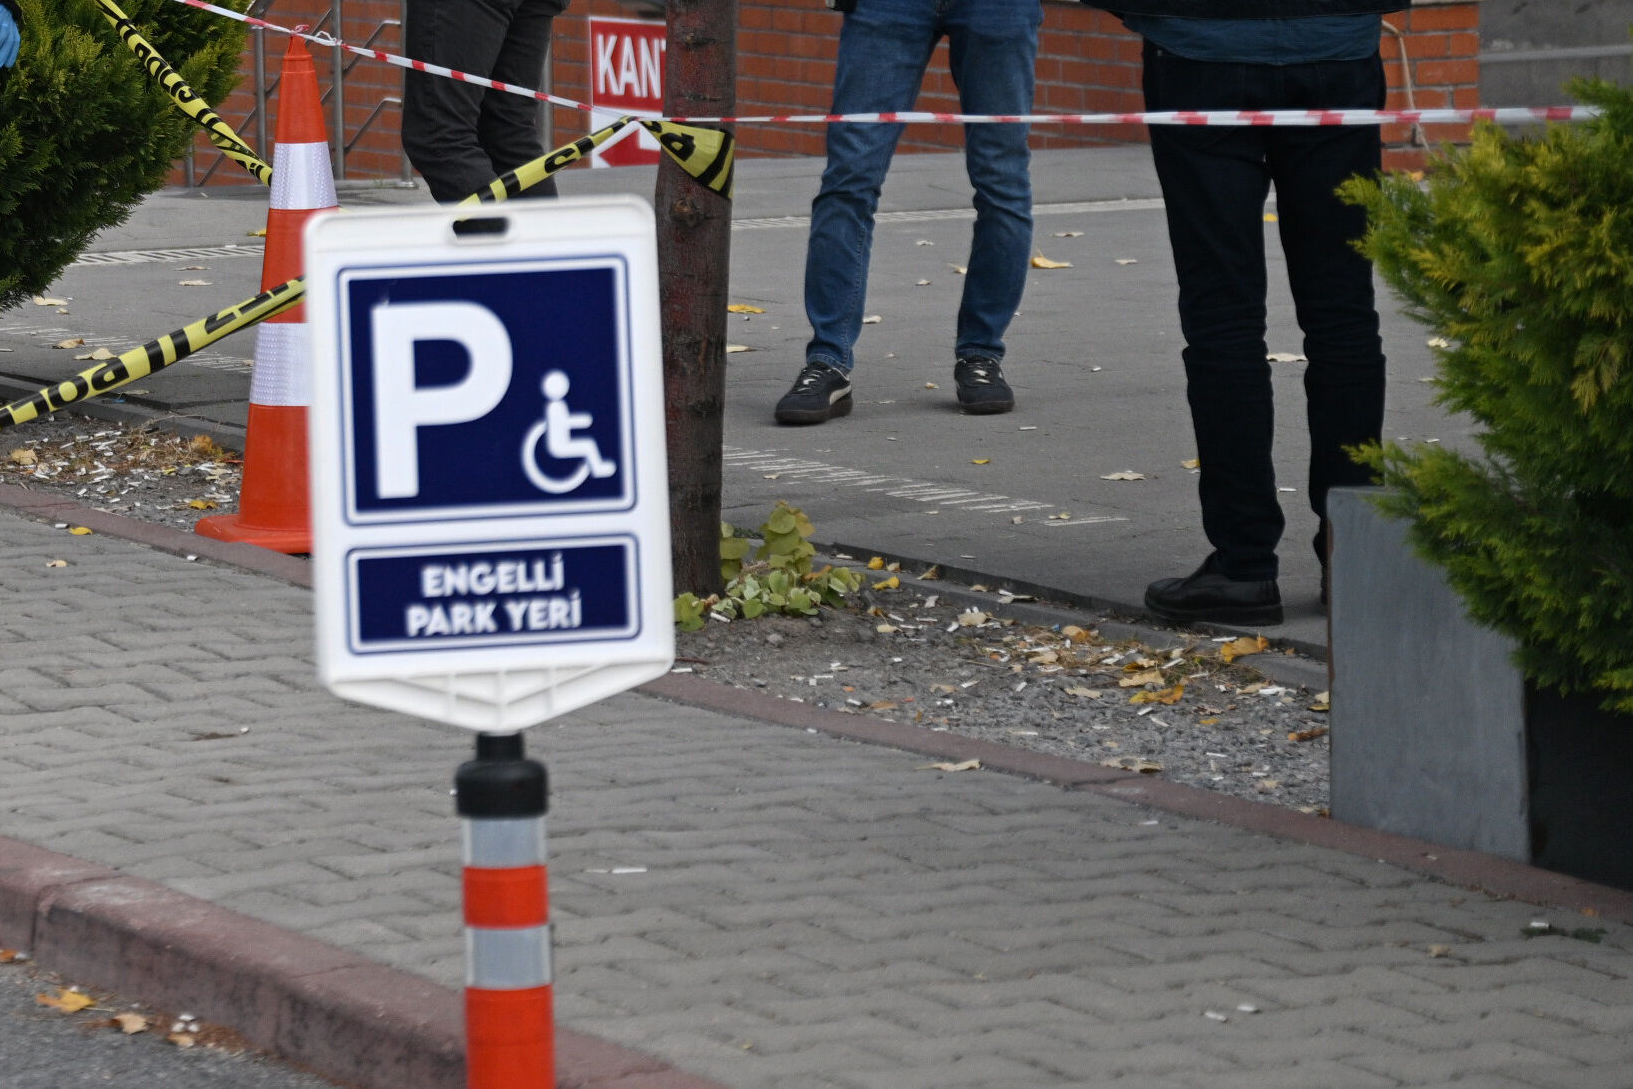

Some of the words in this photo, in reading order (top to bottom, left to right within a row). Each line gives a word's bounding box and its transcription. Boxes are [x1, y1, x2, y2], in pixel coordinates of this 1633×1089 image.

[596, 34, 666, 100] KAN
[371, 300, 513, 499] P
[422, 552, 564, 598] ENGELLİ
[405, 600, 496, 637] PARK
[506, 589, 582, 630] YERİ
